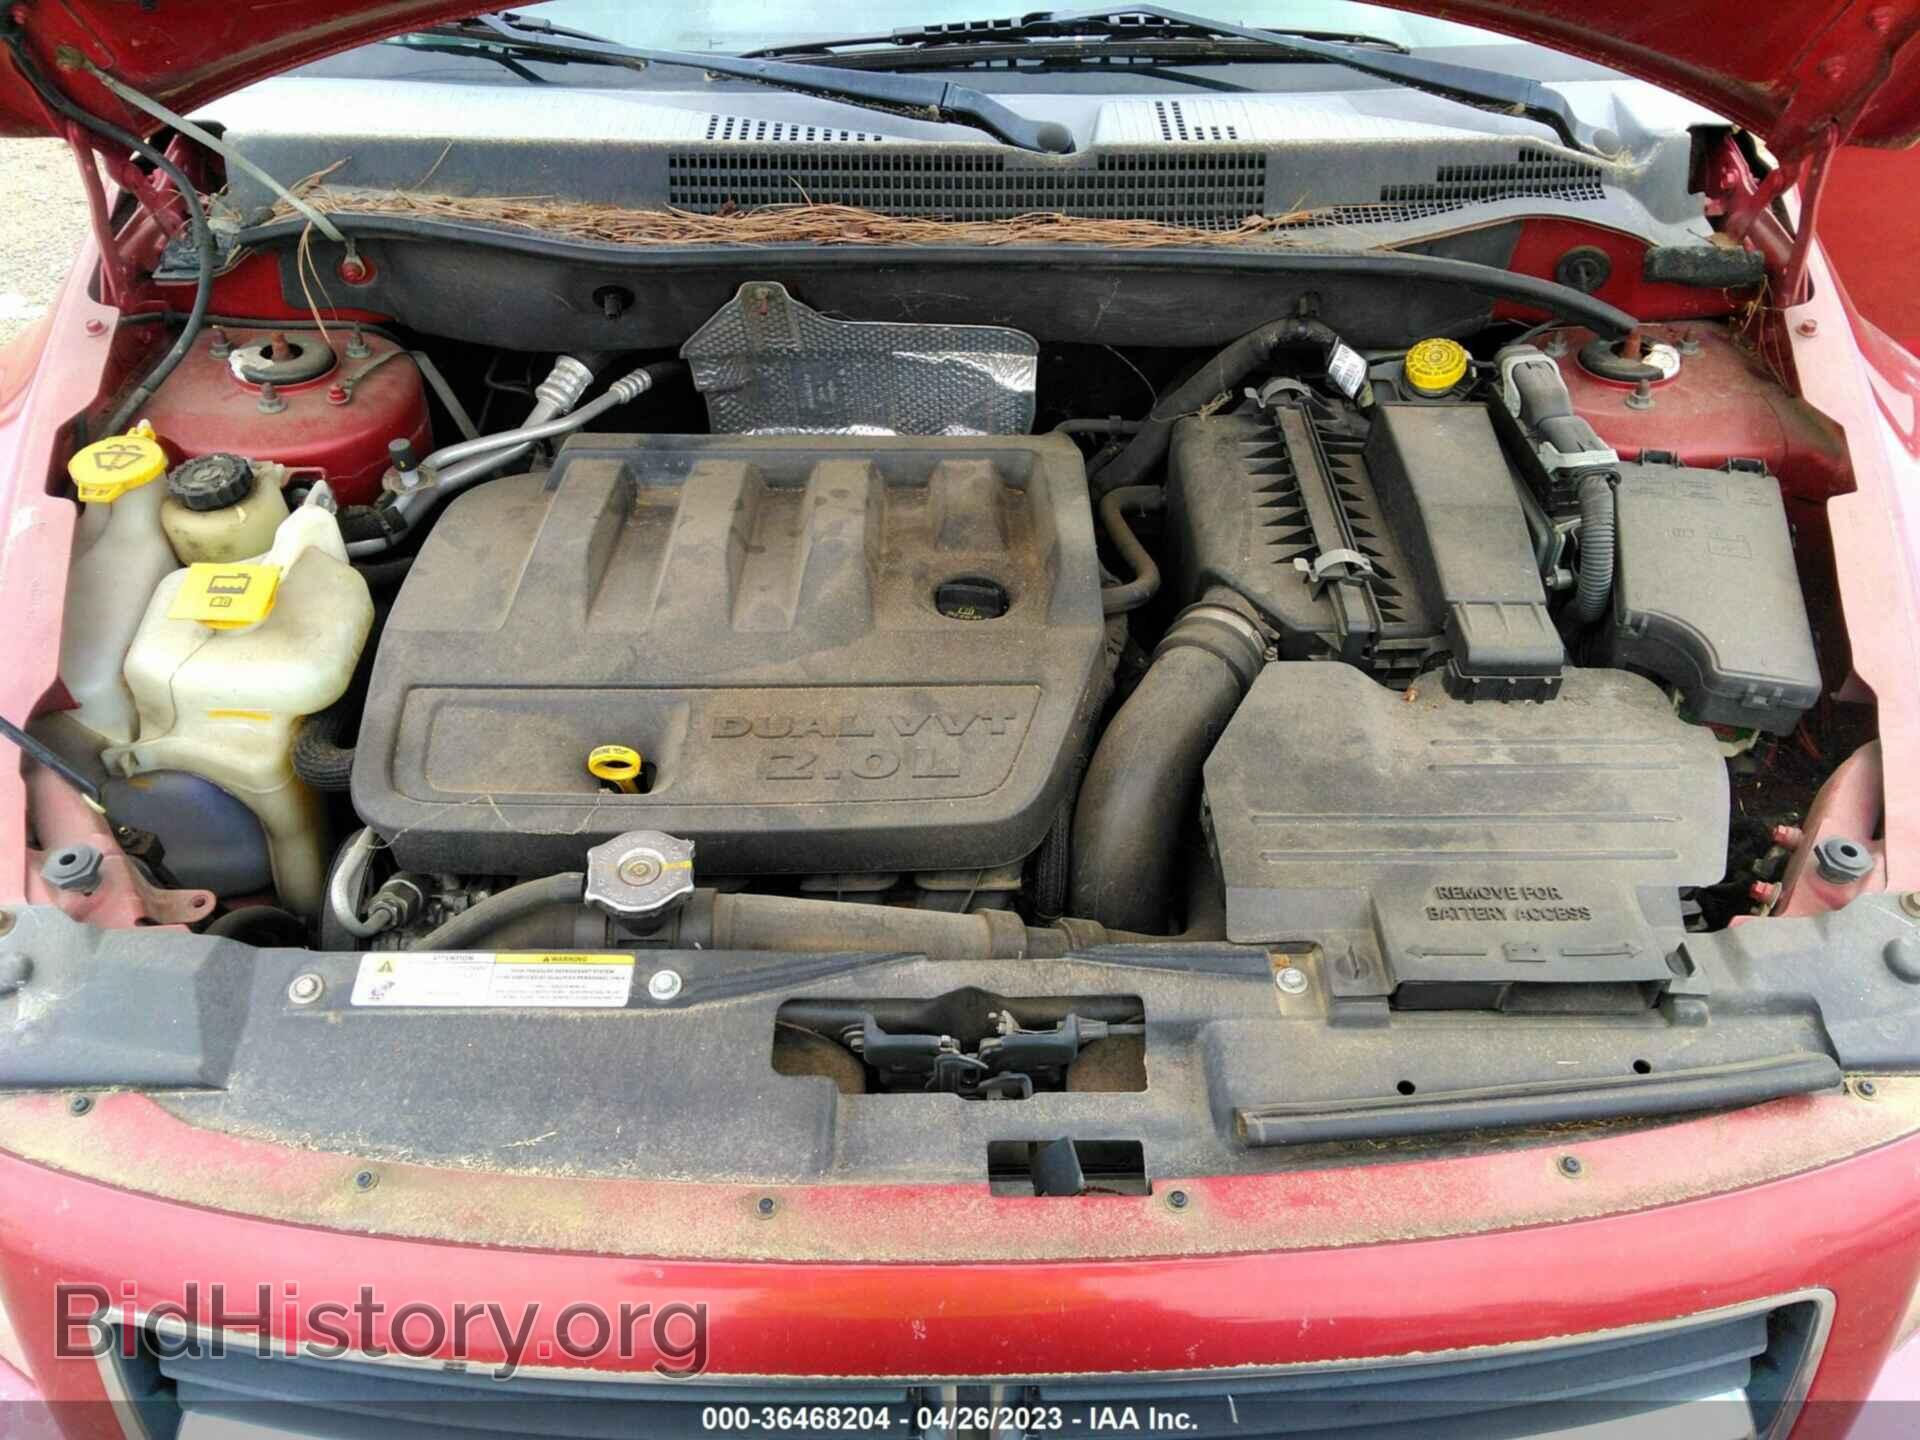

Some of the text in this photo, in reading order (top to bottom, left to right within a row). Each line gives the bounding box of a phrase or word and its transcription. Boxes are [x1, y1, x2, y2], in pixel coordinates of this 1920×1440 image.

[709, 712, 1018, 740] DUAL VVT
[760, 747, 961, 781] 2.0L
[1433, 885, 1563, 902] REMOVE FOR
[1425, 905, 1594, 922] BATTERY ACCESS
